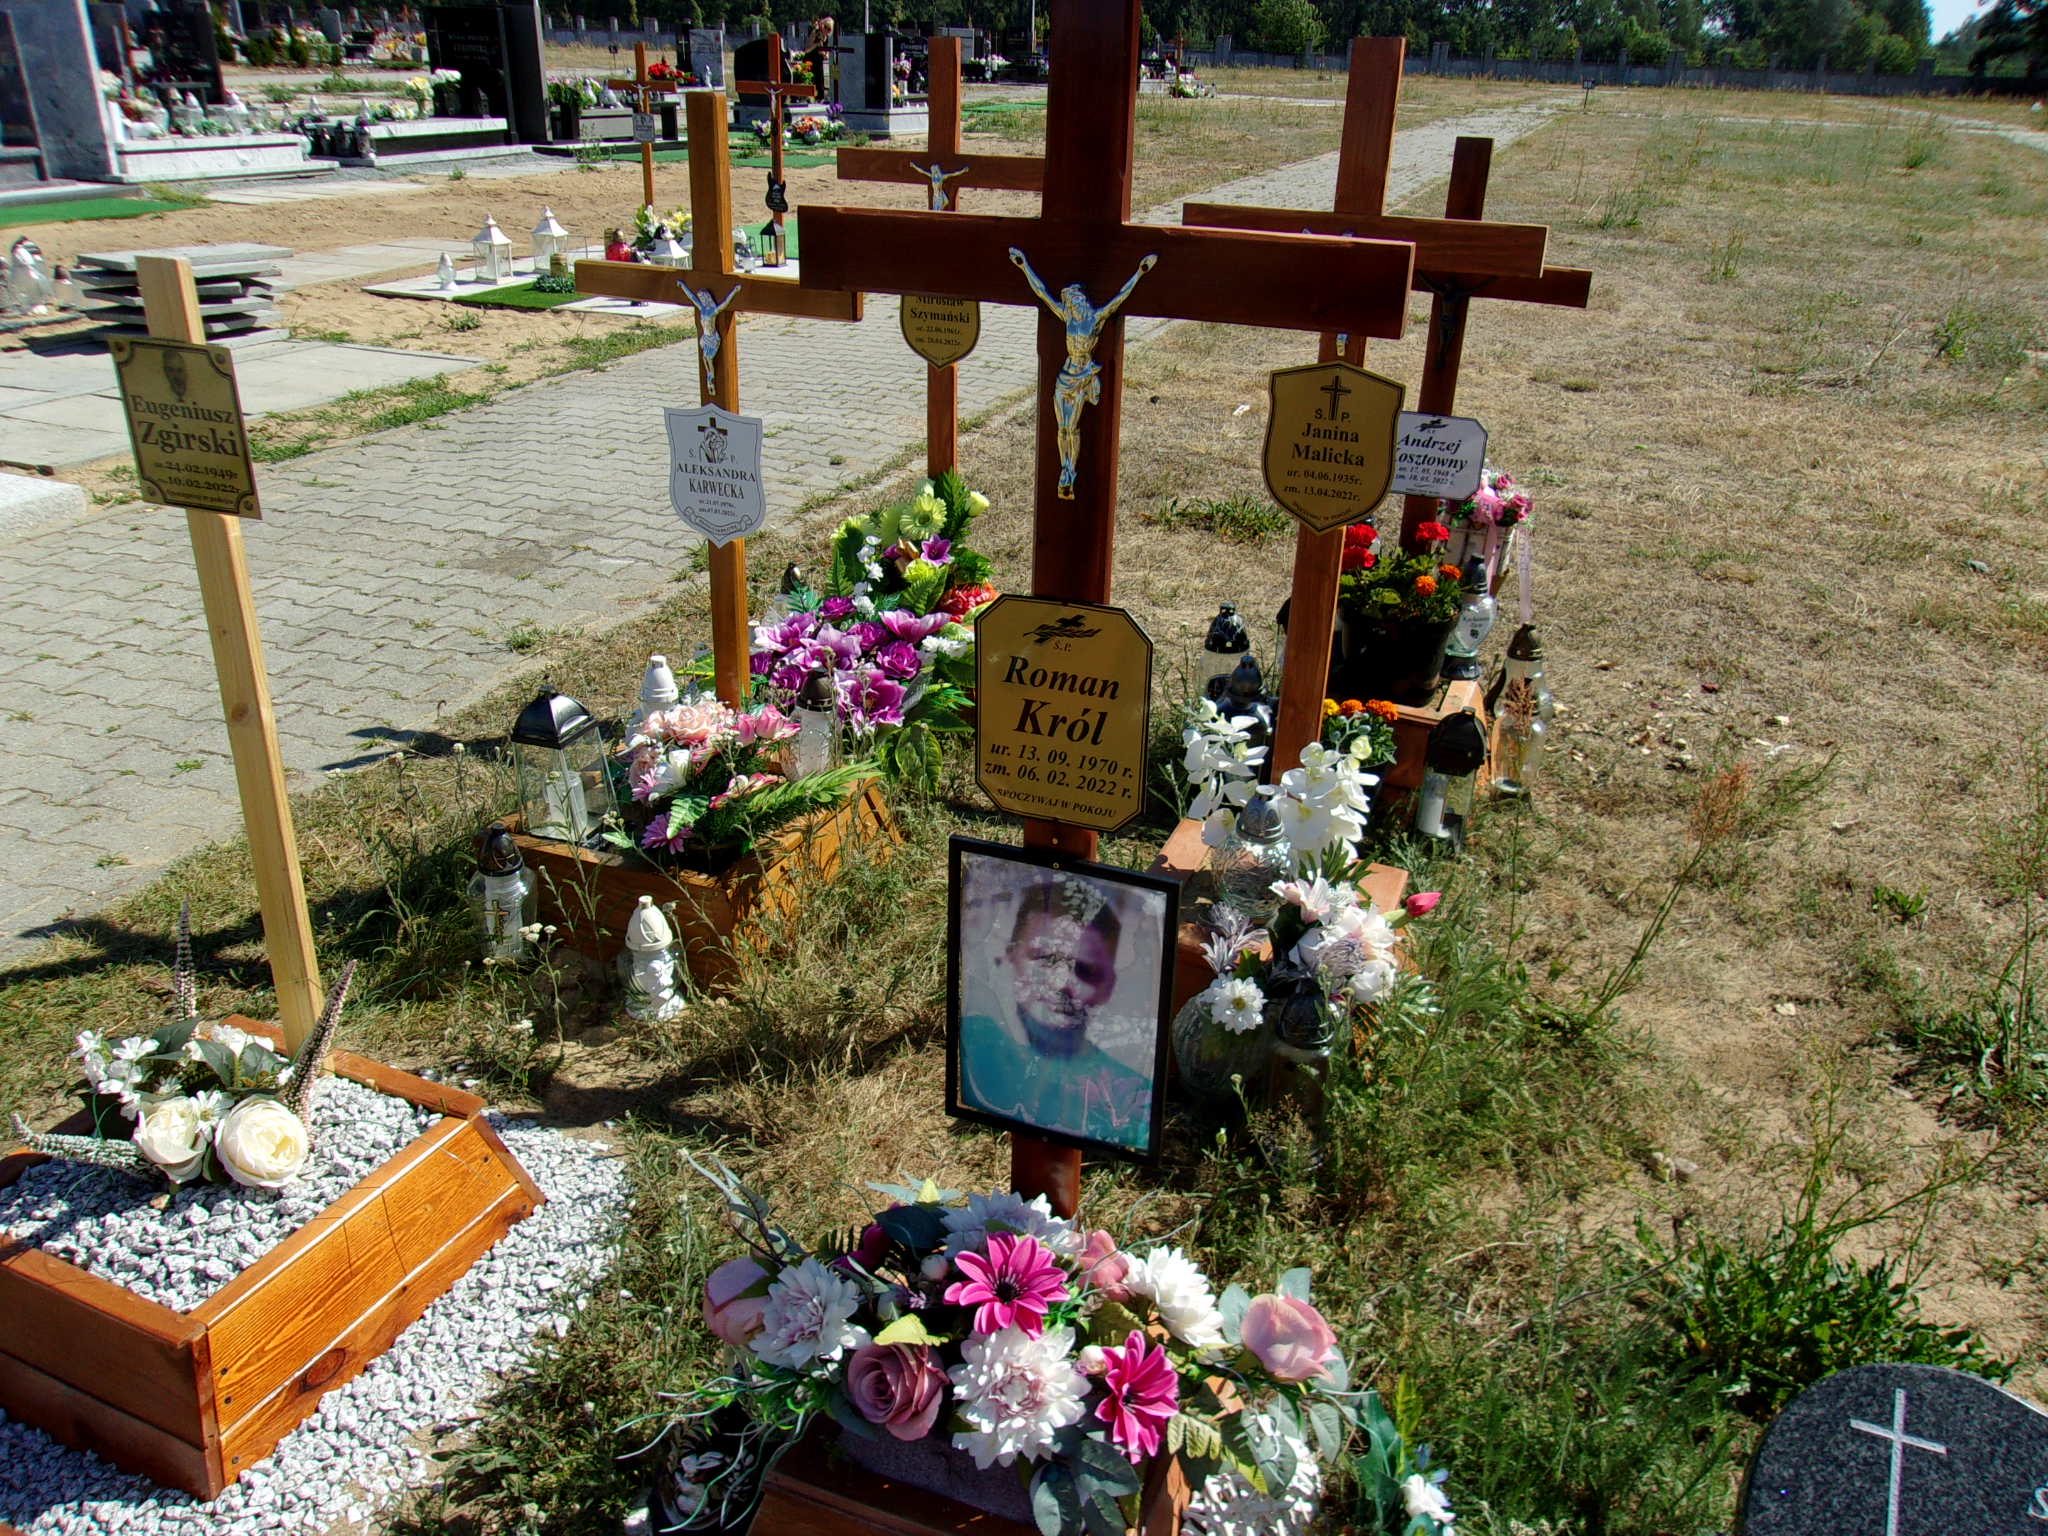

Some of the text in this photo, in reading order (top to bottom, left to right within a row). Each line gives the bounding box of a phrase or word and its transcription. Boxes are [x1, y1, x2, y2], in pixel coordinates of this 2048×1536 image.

[910, 307, 970, 324] Szymański
[130, 395, 234, 424] Eugeniusz
[1340, 411, 1351, 423] P.
[135, 421, 240, 457] Zgirski
[1301, 422, 1360, 444] Janina
[1397, 433, 1462, 455] Andrzej
[1291, 443, 1365, 467] Malicka
[1396, 448, 1468, 473] osztowny
[677, 463, 756, 483] ALEKSANDRA
[1287, 469, 1300, 478] ur.
[689, 478, 745, 499] KARWECKA
[1001, 655, 1120, 700] Roman
[1013, 698, 1109, 746] Król
[990, 743, 1133, 779] ur. 13. 09. 1970 r.
[984, 761, 1132, 799] zm. 06. 02. 2022 r.
[997, 787, 1117, 818] SPOCZYWAJ W POKOJU
